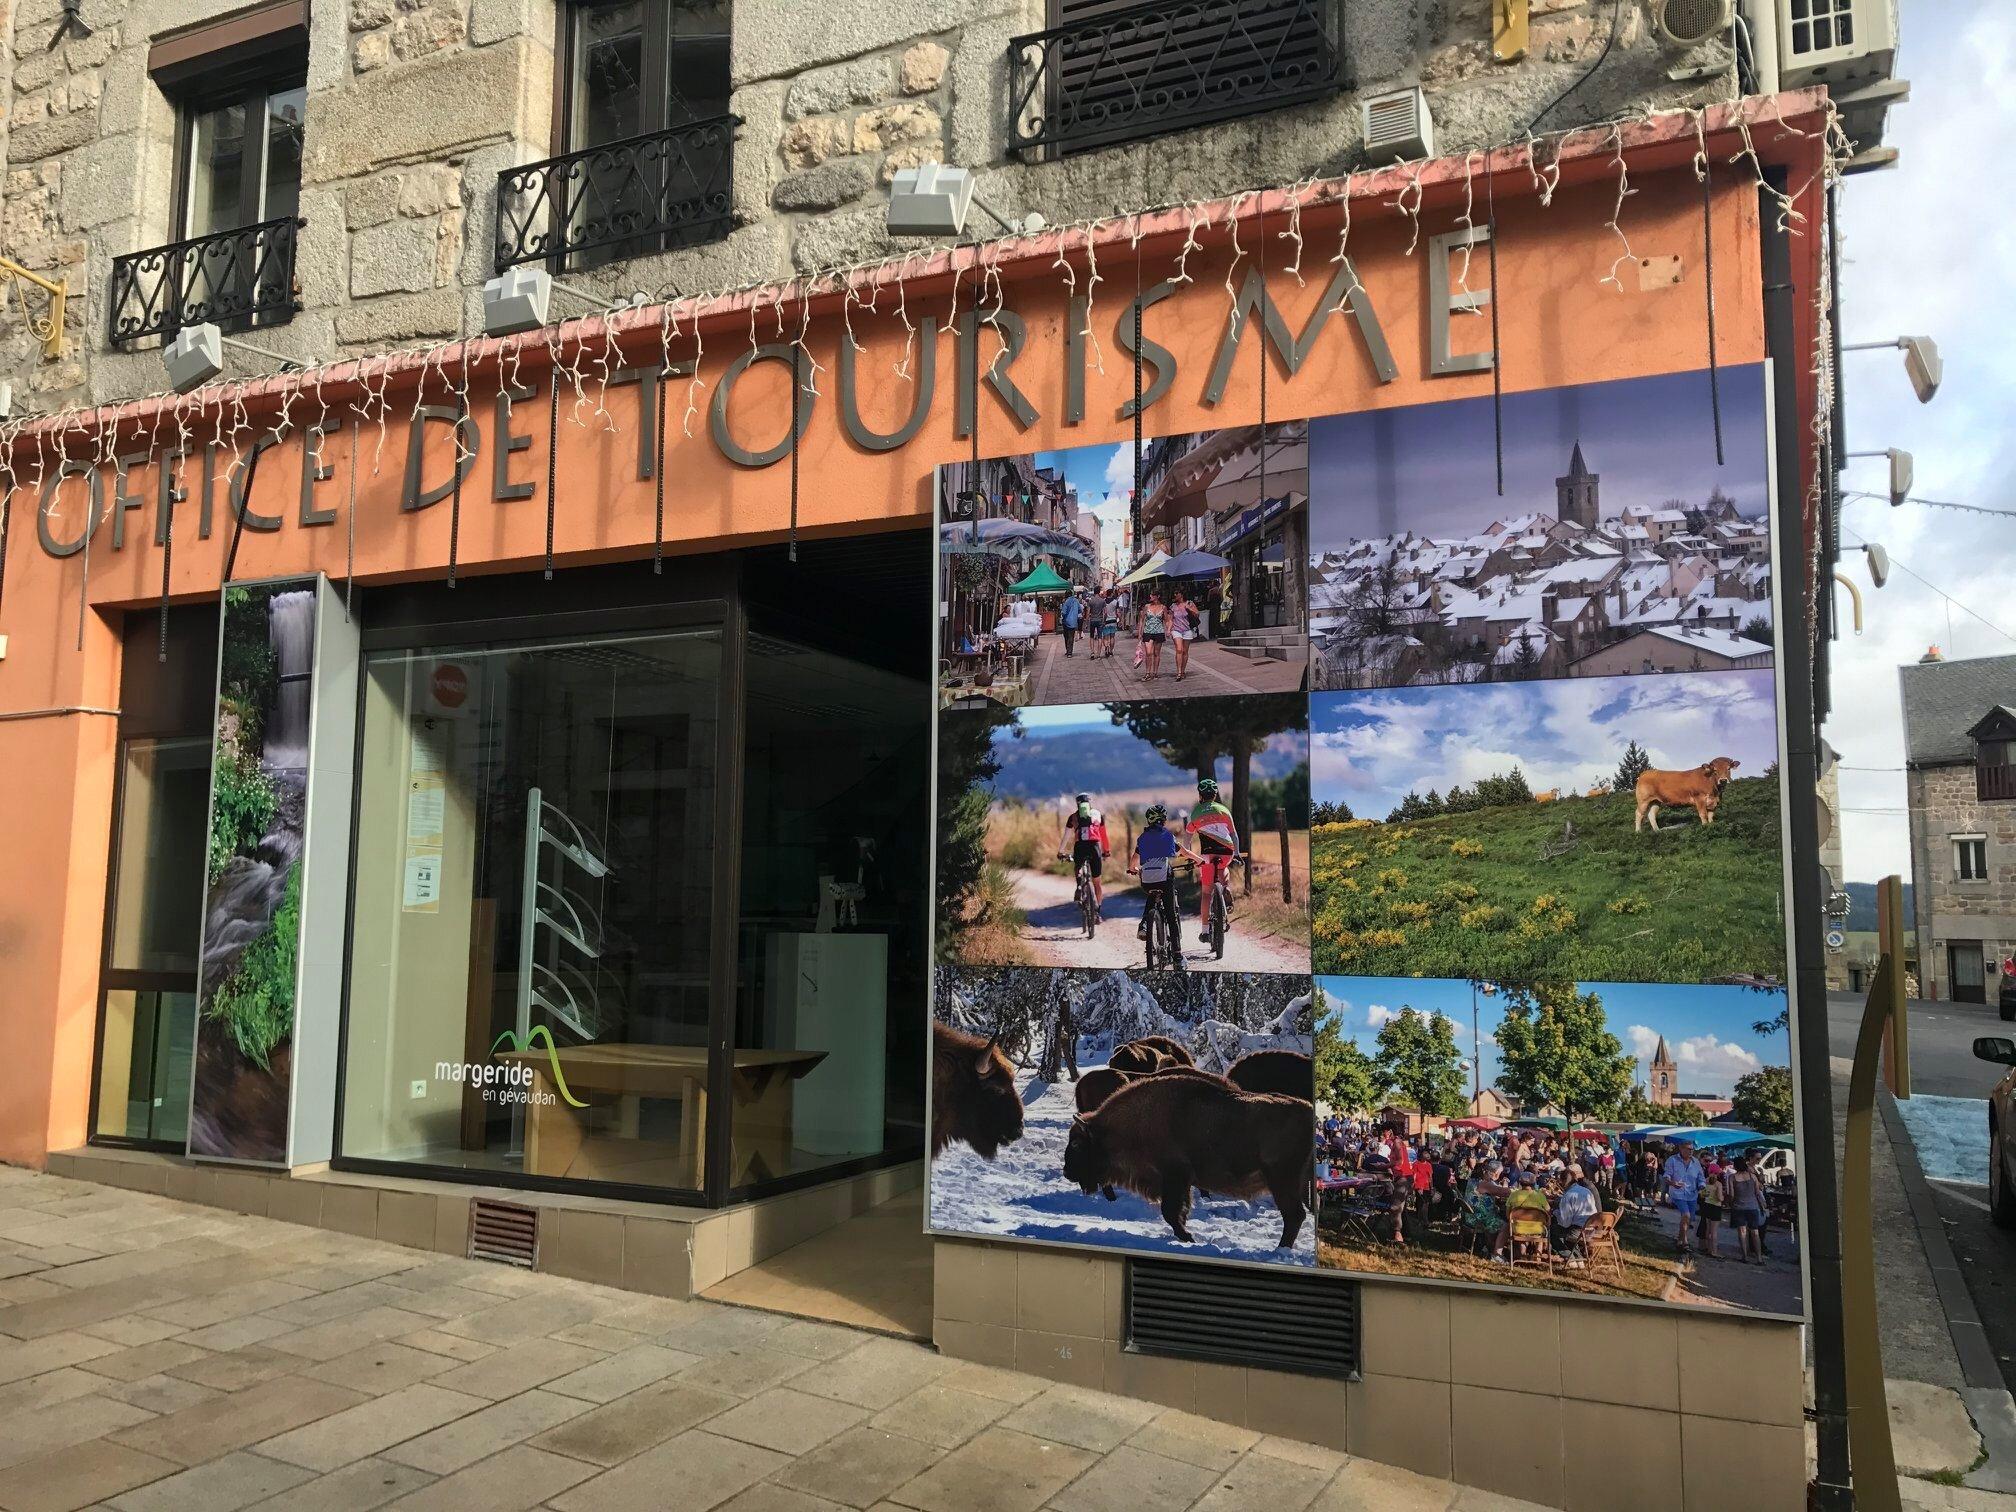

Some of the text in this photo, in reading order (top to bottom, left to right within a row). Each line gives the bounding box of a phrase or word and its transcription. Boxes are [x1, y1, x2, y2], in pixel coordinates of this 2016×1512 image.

[37, 224, 1497, 558] OFFICE DE TOURISME
[434, 1060, 534, 1089] margeride
[482, 1087, 556, 1106] en gévaudan
